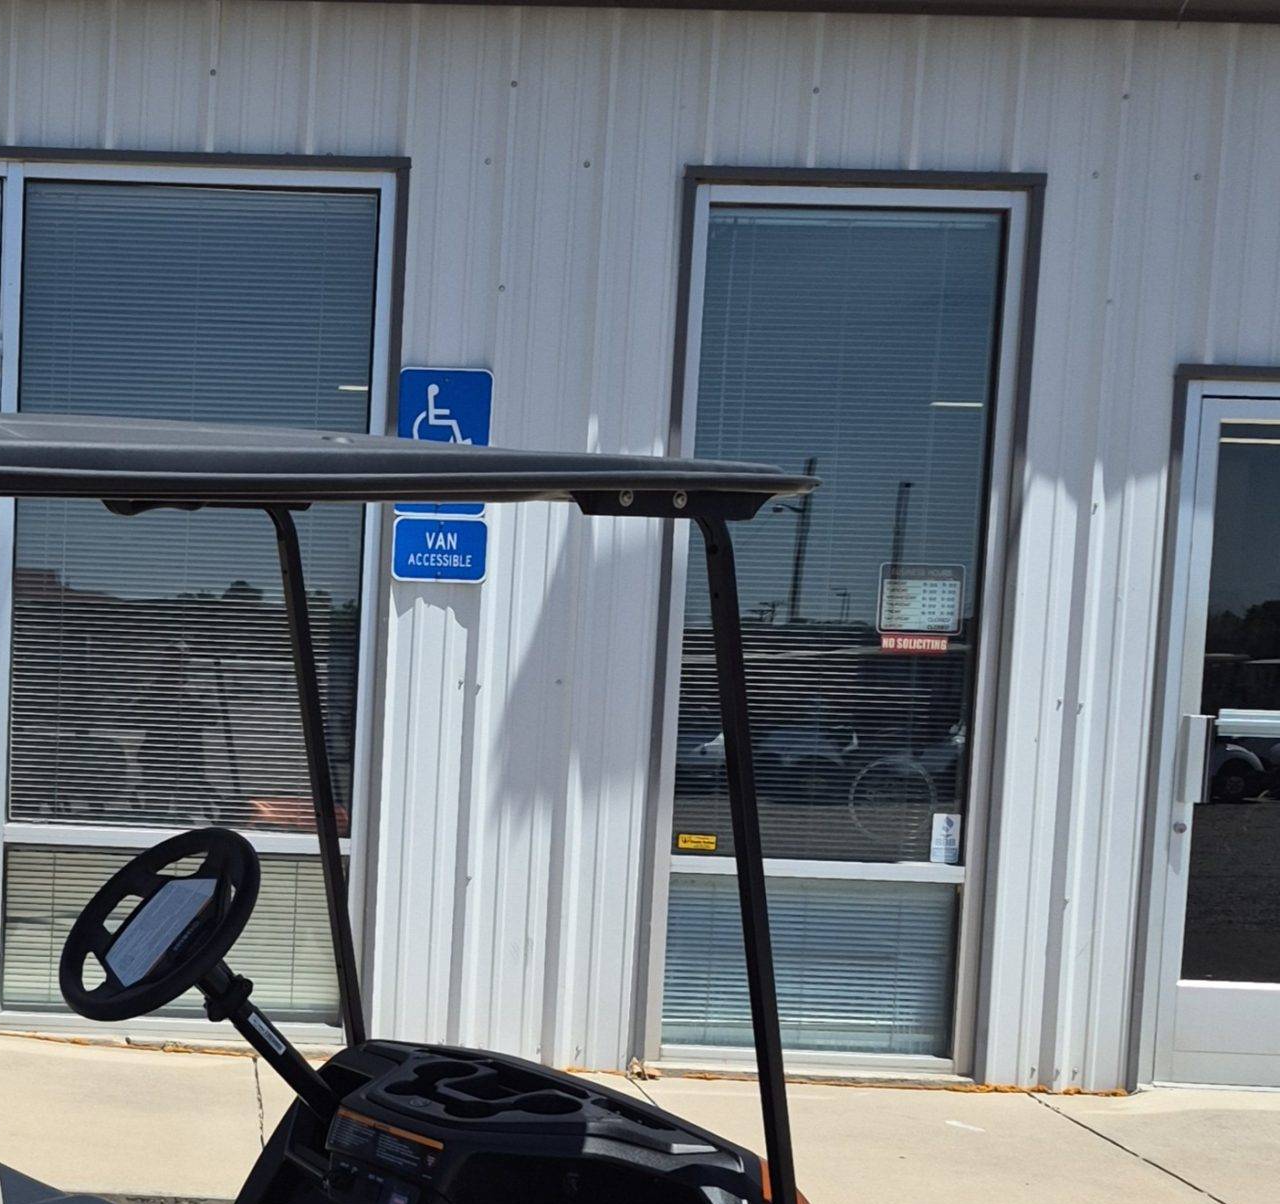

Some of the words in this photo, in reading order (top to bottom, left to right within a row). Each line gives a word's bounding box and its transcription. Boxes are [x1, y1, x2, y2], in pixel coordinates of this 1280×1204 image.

[426, 532, 457, 549] VAN
[407, 553, 473, 568] ACCESSIBLE
[881, 637, 896, 649] NO
[896, 638, 948, 650] SOLICITING
